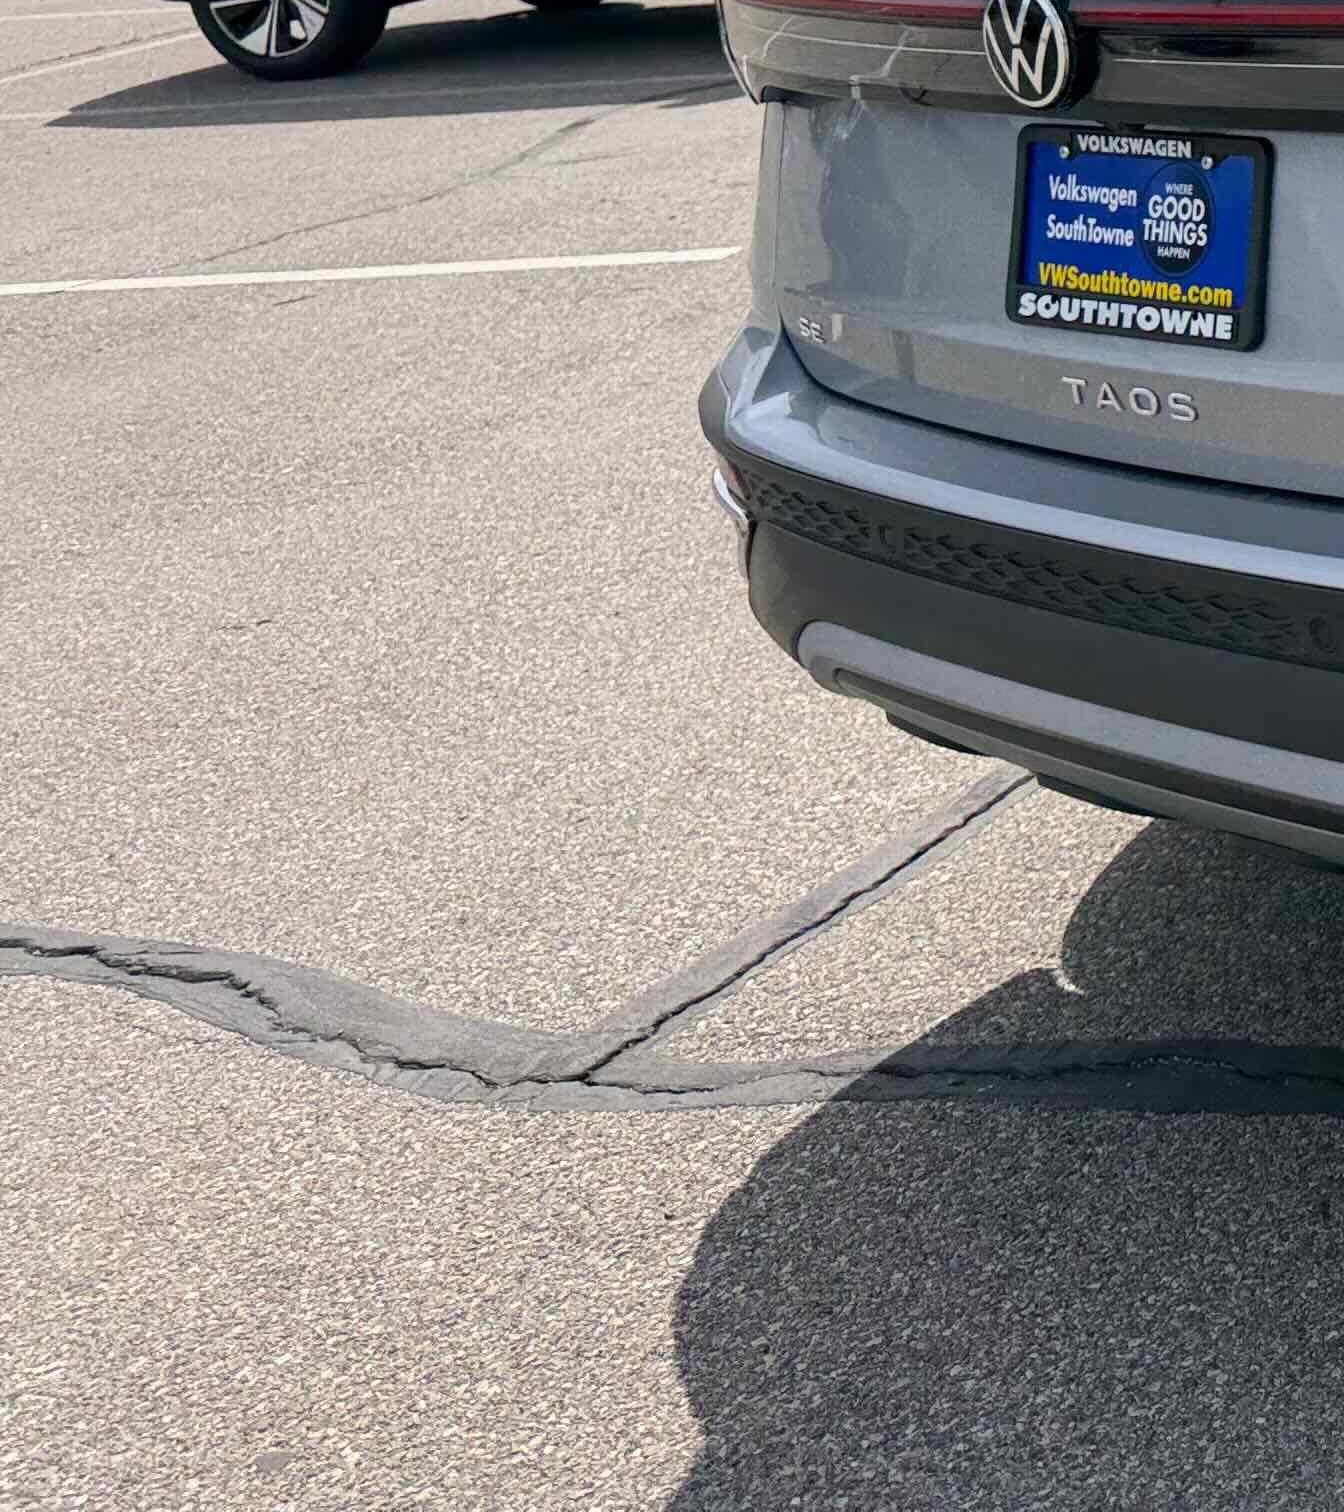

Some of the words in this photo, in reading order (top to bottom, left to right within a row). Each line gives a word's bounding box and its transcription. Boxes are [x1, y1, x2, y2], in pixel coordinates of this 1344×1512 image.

[1076, 134, 1192, 158] VOLKSWAGEN
[1048, 173, 1138, 212] Volkswagen
[1165, 182, 1194, 196] WHERE
[1148, 194, 1206, 222] GOOD
[1046, 213, 1135, 247] SouthTowne
[1142, 219, 1208, 247] THINGS
[1157, 245, 1191, 260] HAPPEN
[1038, 261, 1233, 308] VWSouthtowne.com
[1017, 291, 1235, 341] SOUTHTOWNE
[1061, 376, 1200, 424] TAOS
